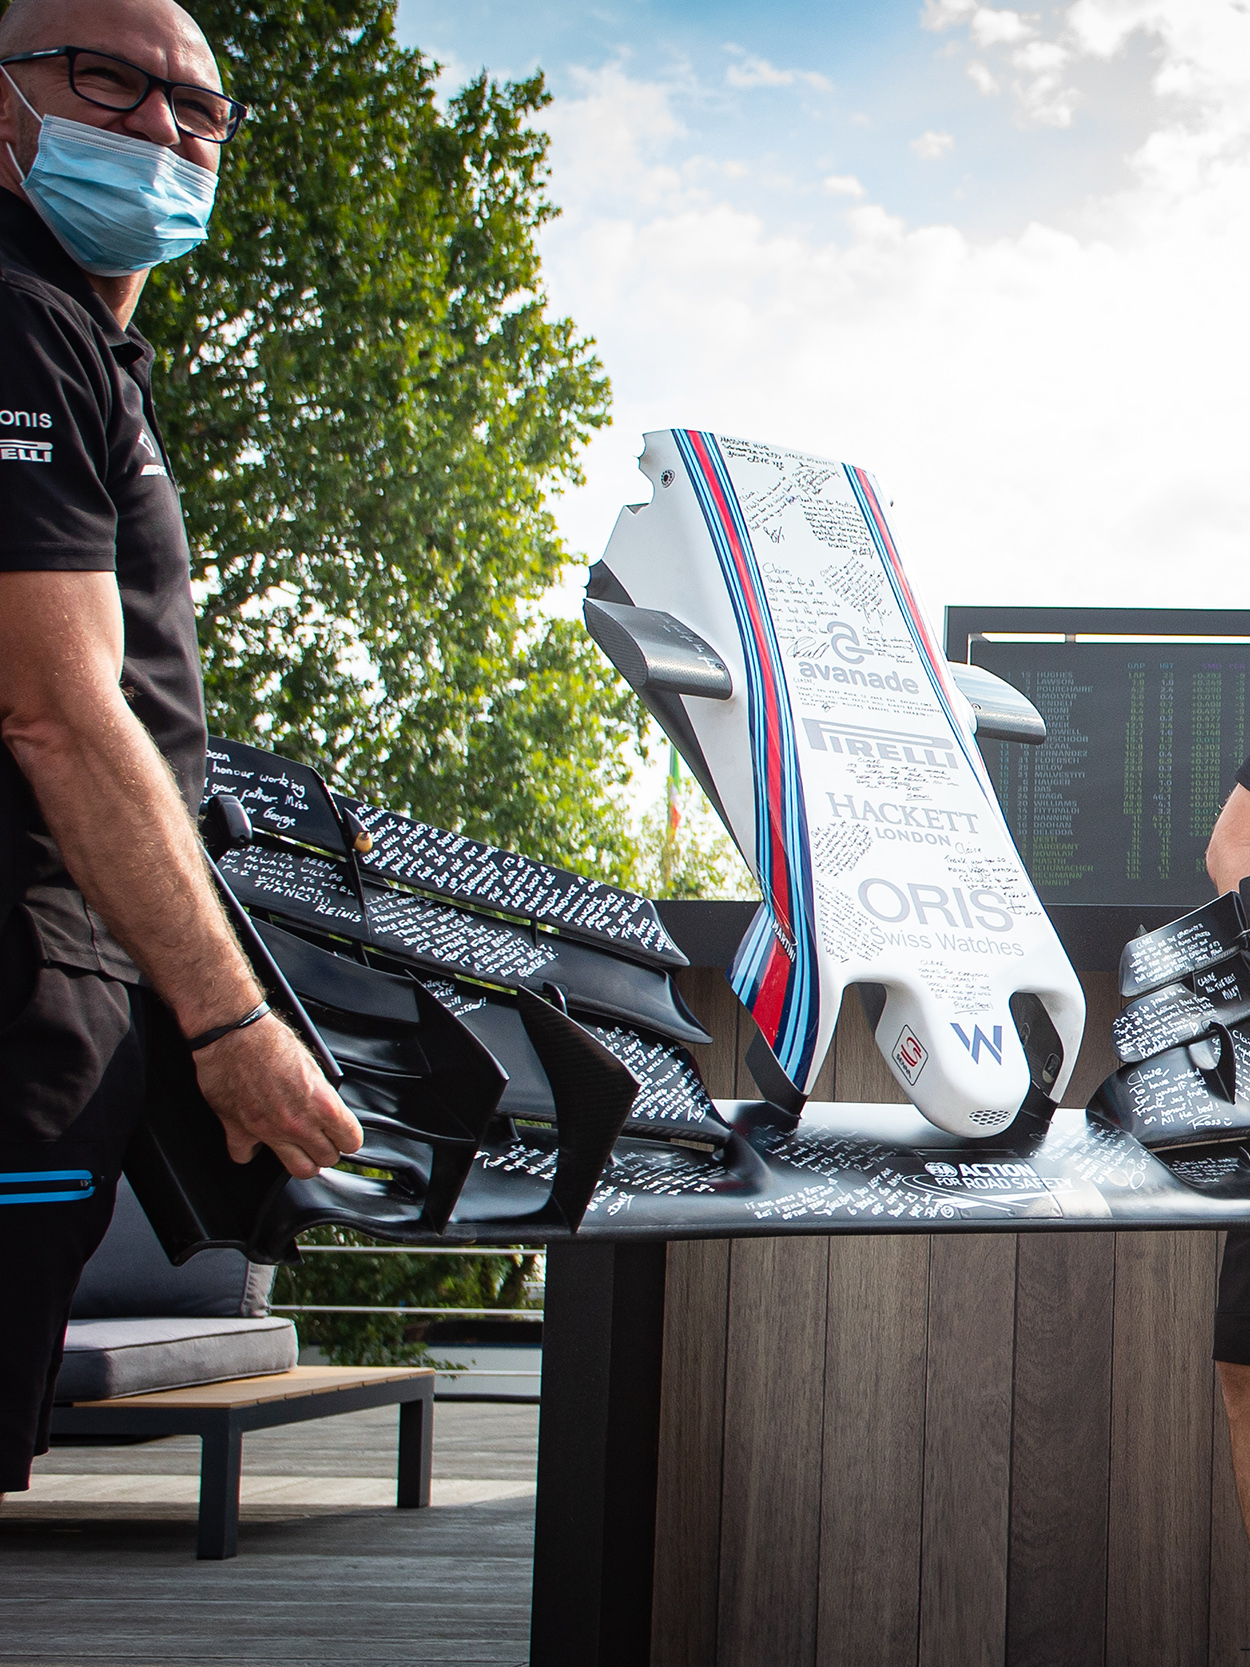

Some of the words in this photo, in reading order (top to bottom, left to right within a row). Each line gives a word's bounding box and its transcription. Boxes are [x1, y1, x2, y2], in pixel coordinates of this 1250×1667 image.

[799, 661, 920, 695] avanade
[801, 717, 959, 769] PIRELLI
[213, 761, 255, 779] honour
[259, 773, 306, 798] working
[825, 792, 979, 834] HACKETT
[875, 827, 951, 846] LONDON
[243, 862, 297, 880] HONOUR
[302, 856, 338, 871] BEEN
[257, 874, 325, 896] WILLIAMS
[857, 877, 1014, 932] ORIS
[771, 920, 797, 963] MARTINI
[870, 926, 932, 949] Swiss
[935, 932, 1025, 957] Watches
[1126, 1067, 1170, 1086] Claire,
[935, 1176, 963, 1187] FOR
[962, 1177, 1016, 1190] ROAD
[1016, 1178, 1074, 1190] SAFETY
[957, 1163, 1038, 1178] ACTION
